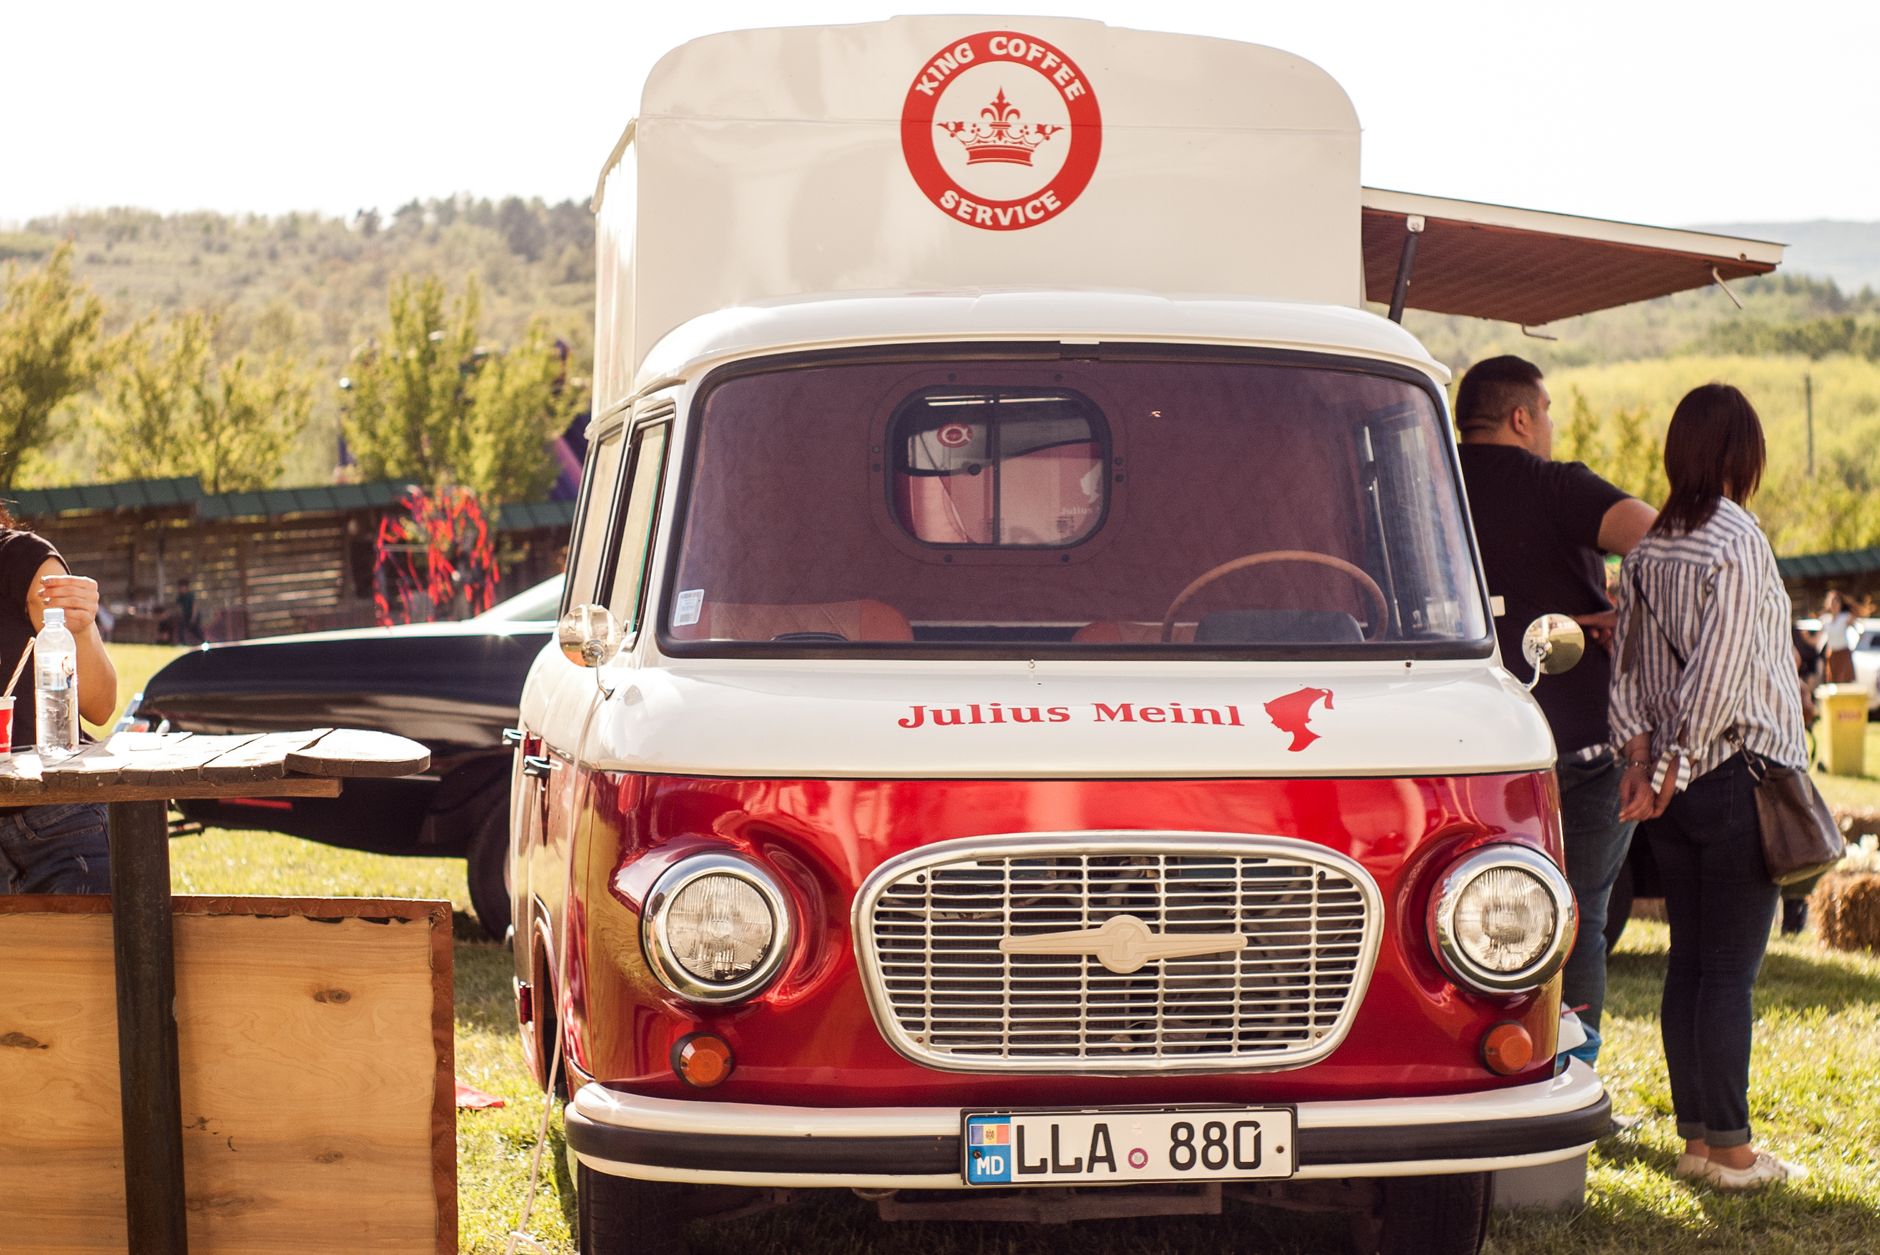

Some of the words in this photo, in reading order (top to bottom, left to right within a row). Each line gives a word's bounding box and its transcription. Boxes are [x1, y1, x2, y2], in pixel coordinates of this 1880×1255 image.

[915, 42, 976, 96] KING
[989, 36, 1086, 101] COFFEE
[939, 189, 1062, 227] SERVICE
[897, 702, 1071, 729] Julius
[1092, 702, 1245, 728] Meinl
[975, 1155, 1005, 1176] MD
[1017, 1123, 1117, 1175] LLA
[1169, 1120, 1262, 1171] 880
